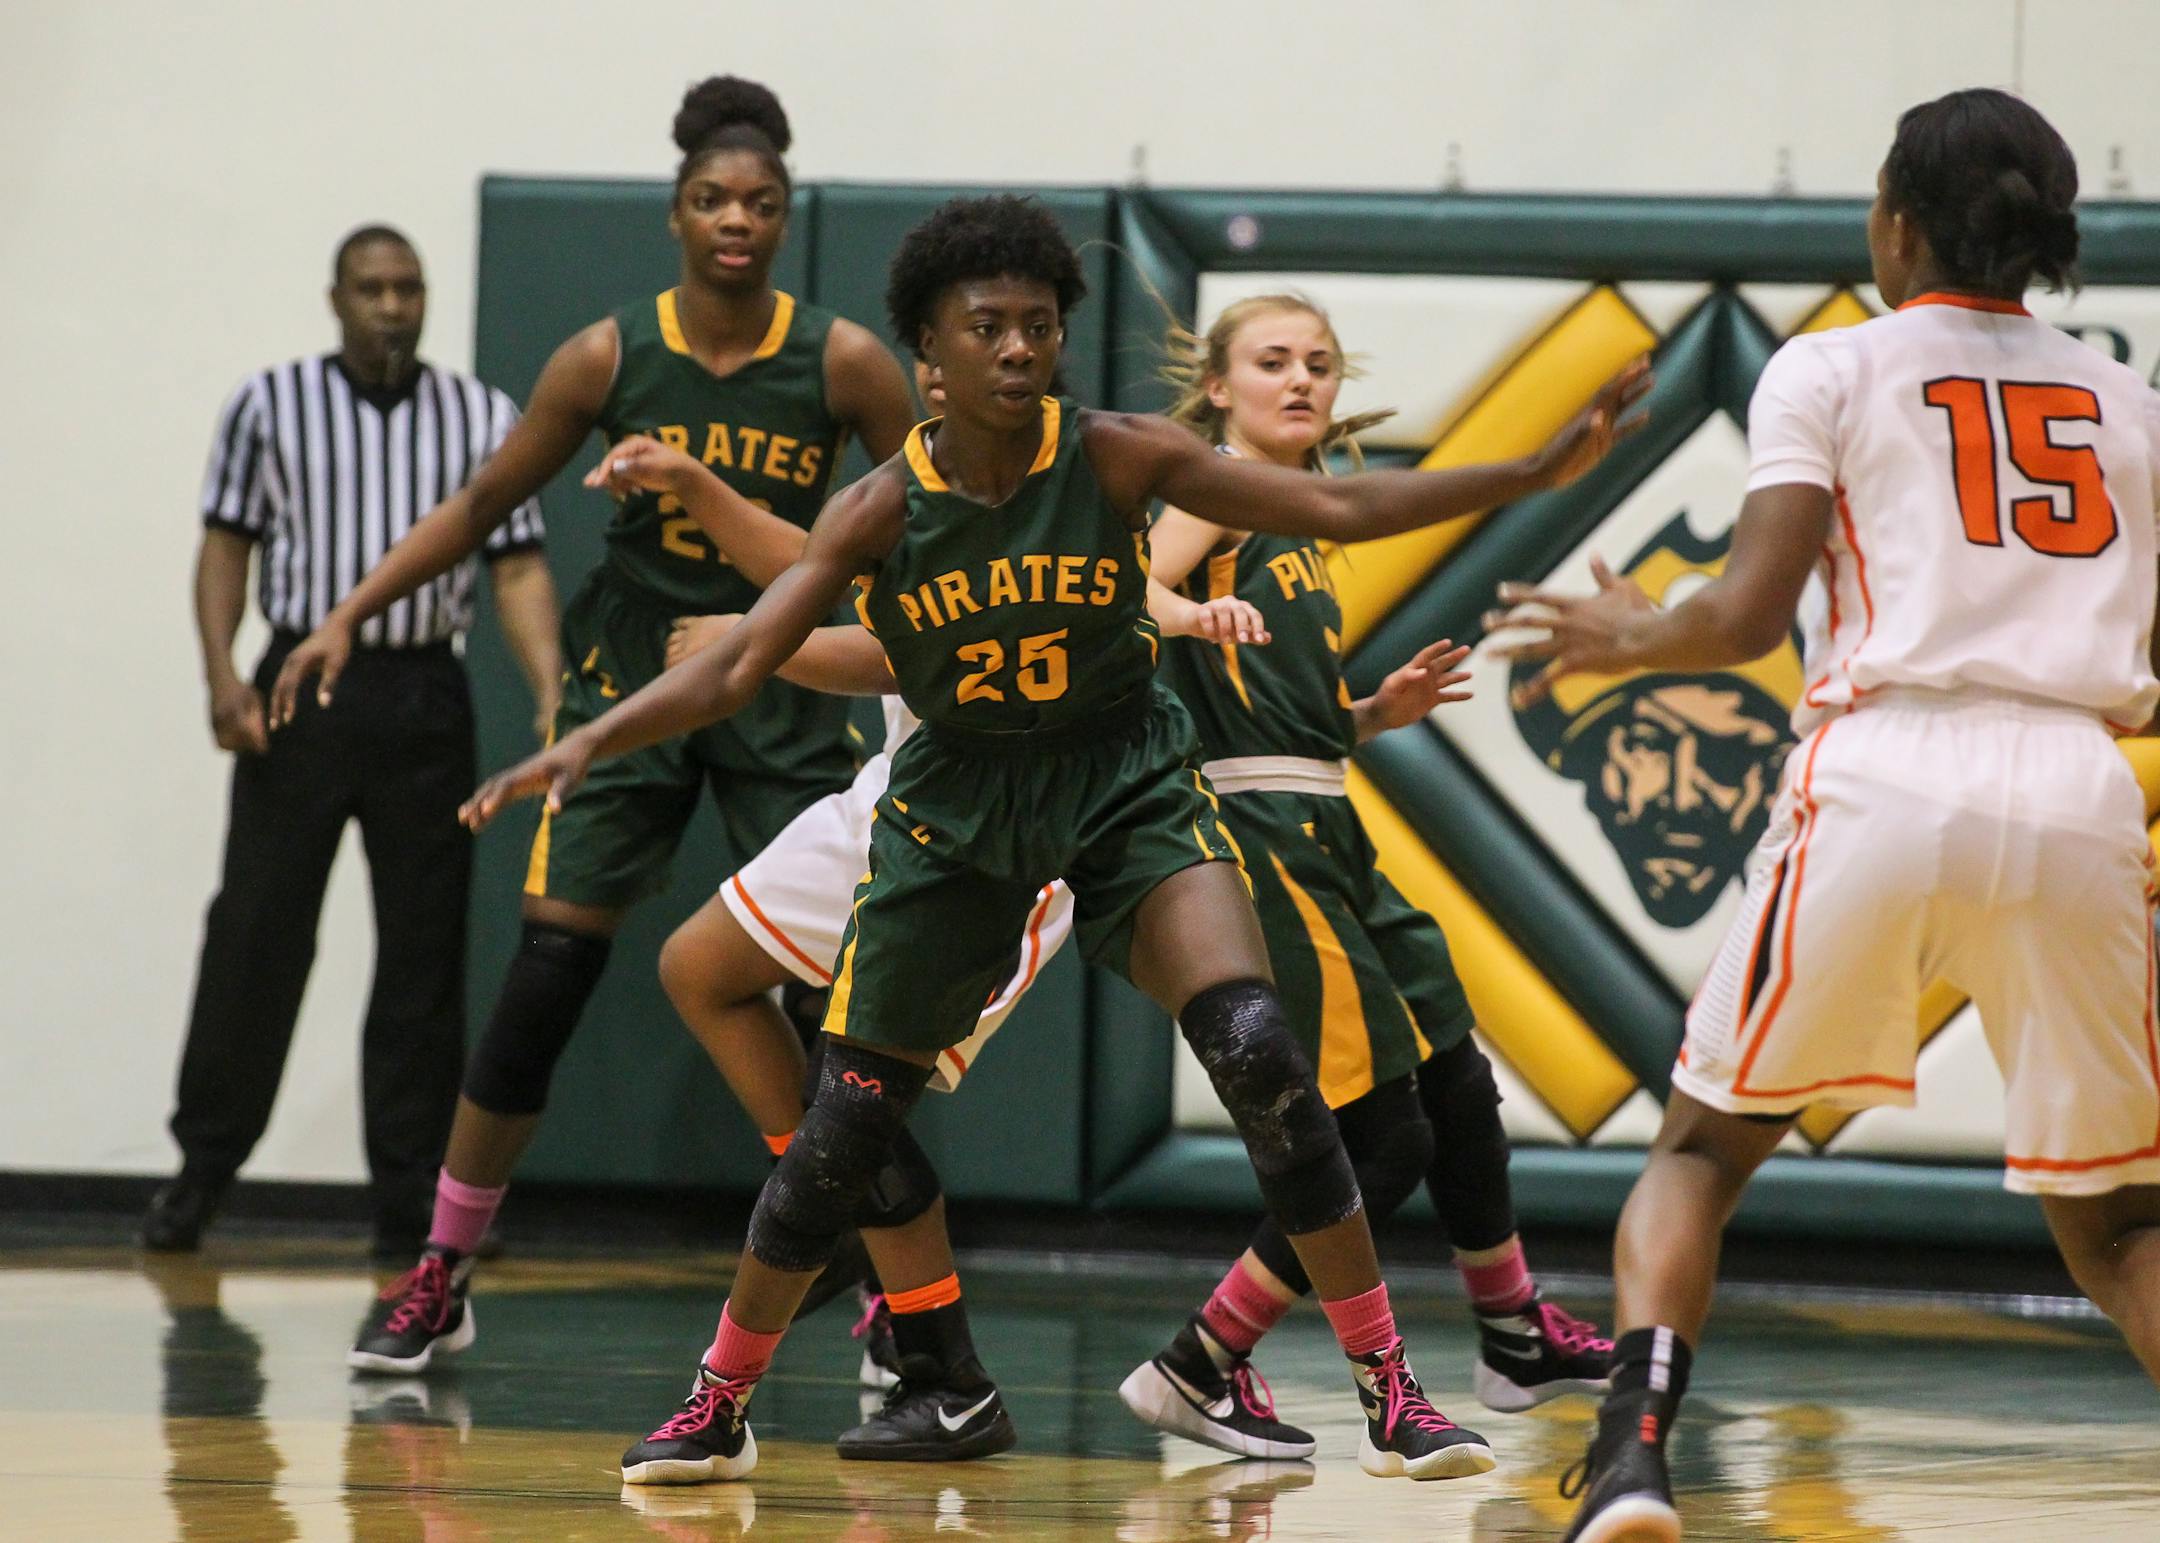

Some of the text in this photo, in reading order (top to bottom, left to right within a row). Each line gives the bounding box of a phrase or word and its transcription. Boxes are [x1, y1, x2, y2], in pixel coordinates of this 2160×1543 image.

[1923, 375, 2118, 558] 15
[898, 554, 1120, 632] PIRATES
[956, 627, 1069, 706] 25
